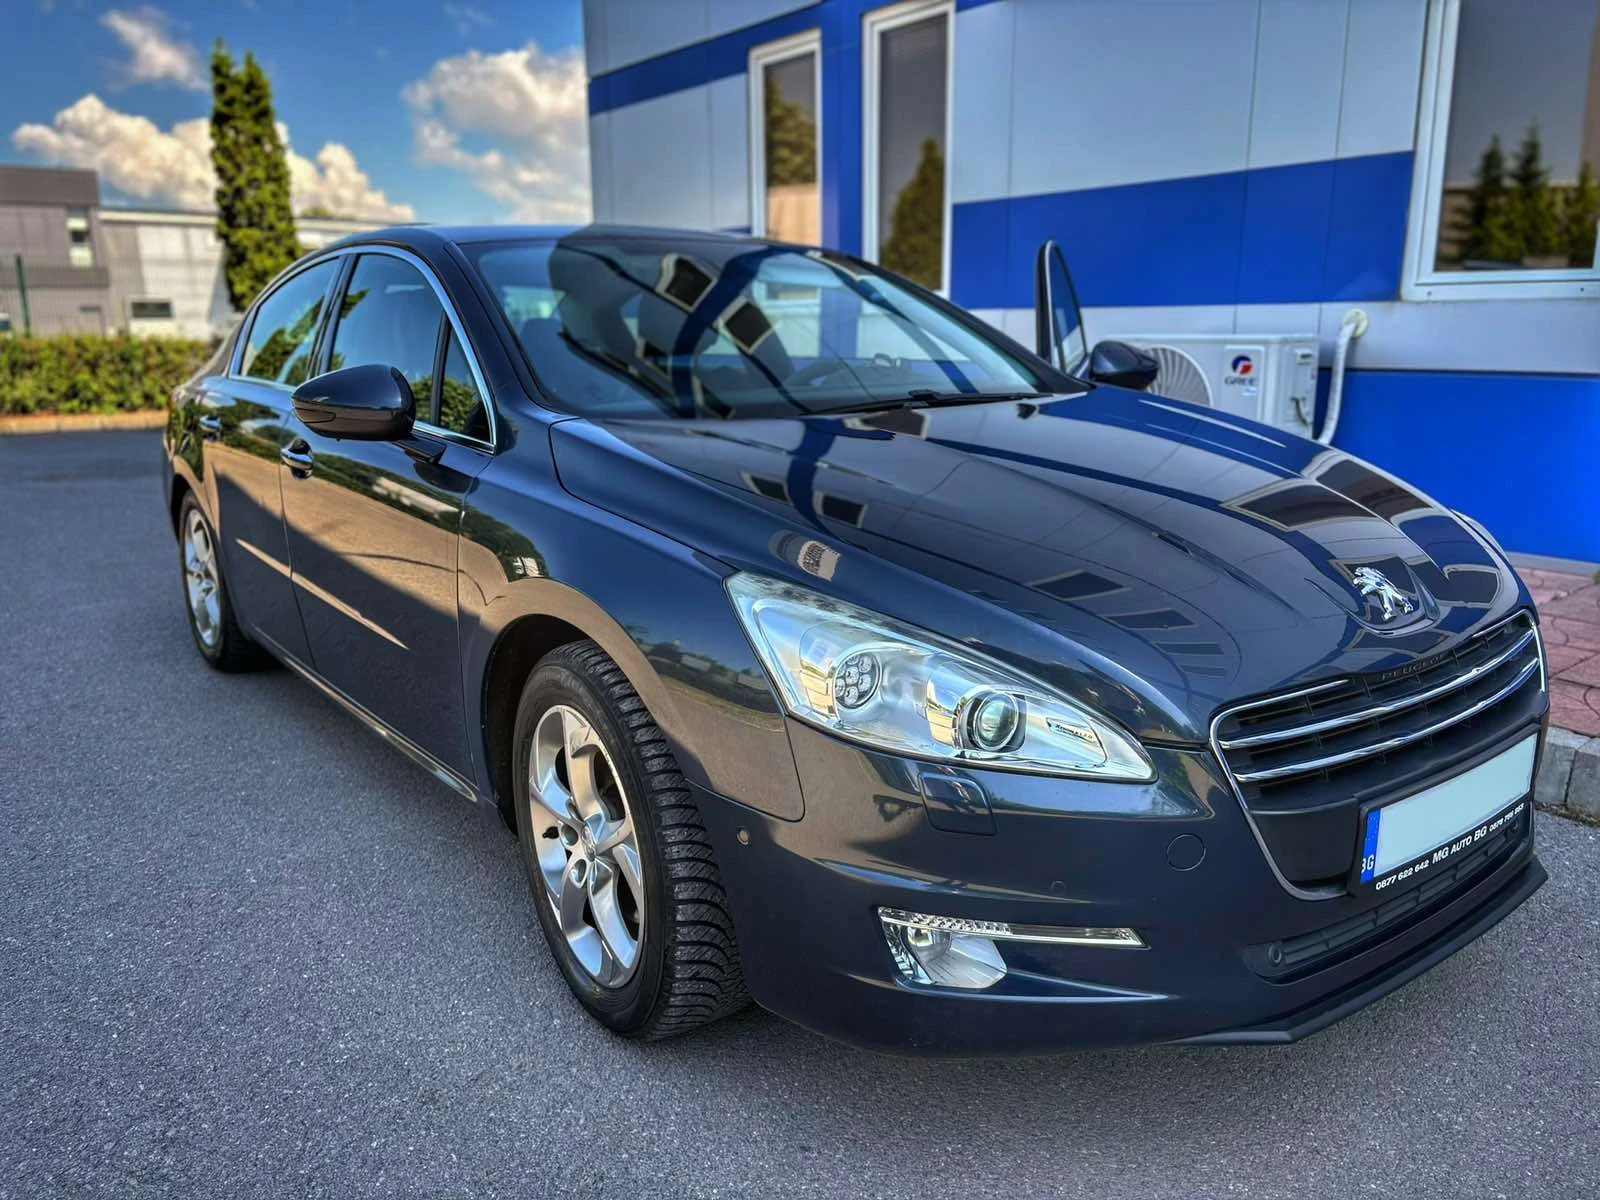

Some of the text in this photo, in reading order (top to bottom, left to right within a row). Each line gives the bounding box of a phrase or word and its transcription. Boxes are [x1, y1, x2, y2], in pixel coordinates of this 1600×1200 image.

[1375, 874, 1397, 891] 0877
[1397, 867, 1414, 881] 622
[1414, 859, 1430, 873] 642
[1432, 846, 1449, 864] MG
[1450, 835, 1473, 855] AUTO
[1473, 825, 1488, 842] BG
